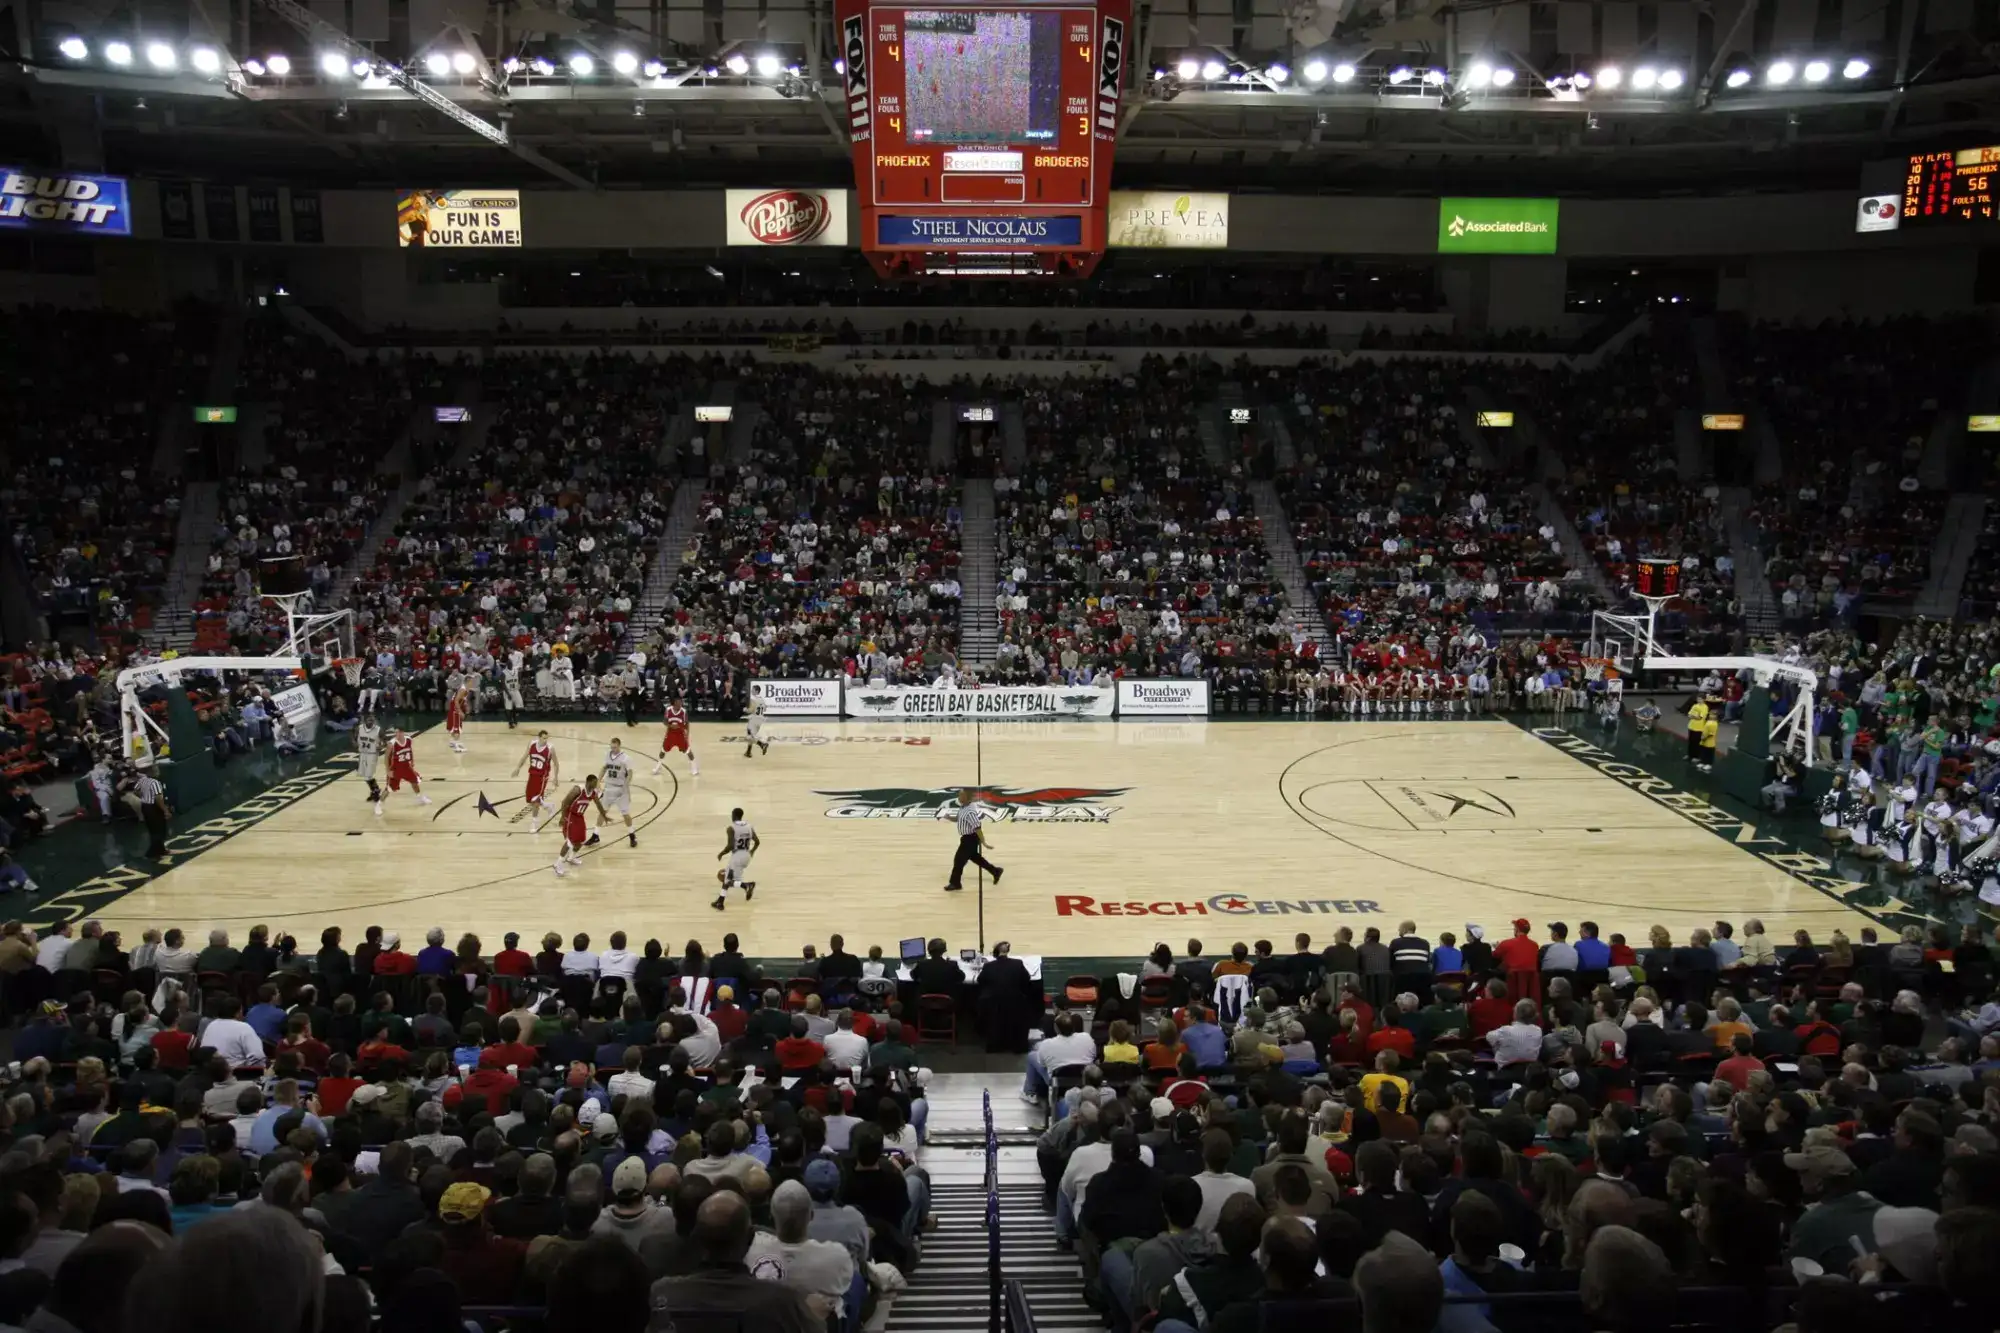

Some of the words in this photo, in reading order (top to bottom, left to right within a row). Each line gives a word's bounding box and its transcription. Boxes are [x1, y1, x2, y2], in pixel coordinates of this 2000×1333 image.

[879, 24, 897, 33] TIME
[1071, 25, 1088, 34] TIME
[879, 33, 898, 42] OUTS
[1070, 34, 1089, 43] OUTS
[844, 18, 867, 93] FOX
[888, 45, 900, 62] 4
[1079, 46, 1090, 63] 4
[1100, 18, 1123, 95] FOX
[879, 97, 898, 105] TEAM
[1068, 98, 1088, 106] TEAM
[850, 97, 870, 128] 11
[877, 105, 900, 114] FOULS
[1066, 106, 1089, 115] FOULS
[1098, 101, 1116, 129] 11
[889, 117, 901, 133] 4
[1079, 117, 1089, 136] 3
[876, 155, 931, 167] PHOENIX
[1033, 156, 1090, 168] BADGERS
[1911, 164, 1923, 174] 10
[1956, 164, 1999, 176] PHOENIX
[2, 173, 99, 200] BUD
[1906, 174, 1921, 185] 20
[1967, 176, 1988, 191] 56
[1906, 185, 1920, 196] 31
[473, 200, 514, 208] CASINO
[1905, 196, 1919, 207] 34
[1952, 196, 1975, 205] FOULS
[0, 196, 116, 223] LIGHT
[774, 198, 798, 219] Dr
[1903, 206, 1918, 217] 50
[1962, 208, 1972, 219] 4
[1982, 206, 1991, 217] 4
[447, 212, 480, 227] FUN
[485, 212, 501, 227] IS
[757, 203, 814, 238] Pepper
[1127, 209, 1226, 227] PREVEA
[911, 219, 960, 236] STIFEL
[966, 219, 1047, 236] NICOLAUS
[1466, 221, 1524, 233] Associated
[1524, 222, 1549, 233] Bank
[429, 230, 464, 245] OUR
[468, 230, 520, 245] GAME!
[764, 684, 825, 699] Broadway
[1132, 683, 1193, 699] Broadway
[903, 693, 945, 713] GREEN
[949, 693, 974, 713] BAY
[976, 693, 1058, 713] BASKETBALL
[398, 751, 411, 763] 24
[1006, 804, 1126, 819] BAY
[1758, 851, 1946, 925] BAY
[1053, 894, 1208, 917] RESCH
[1205, 892, 1386, 915] CENTER
[866, 982, 885, 992] 30
